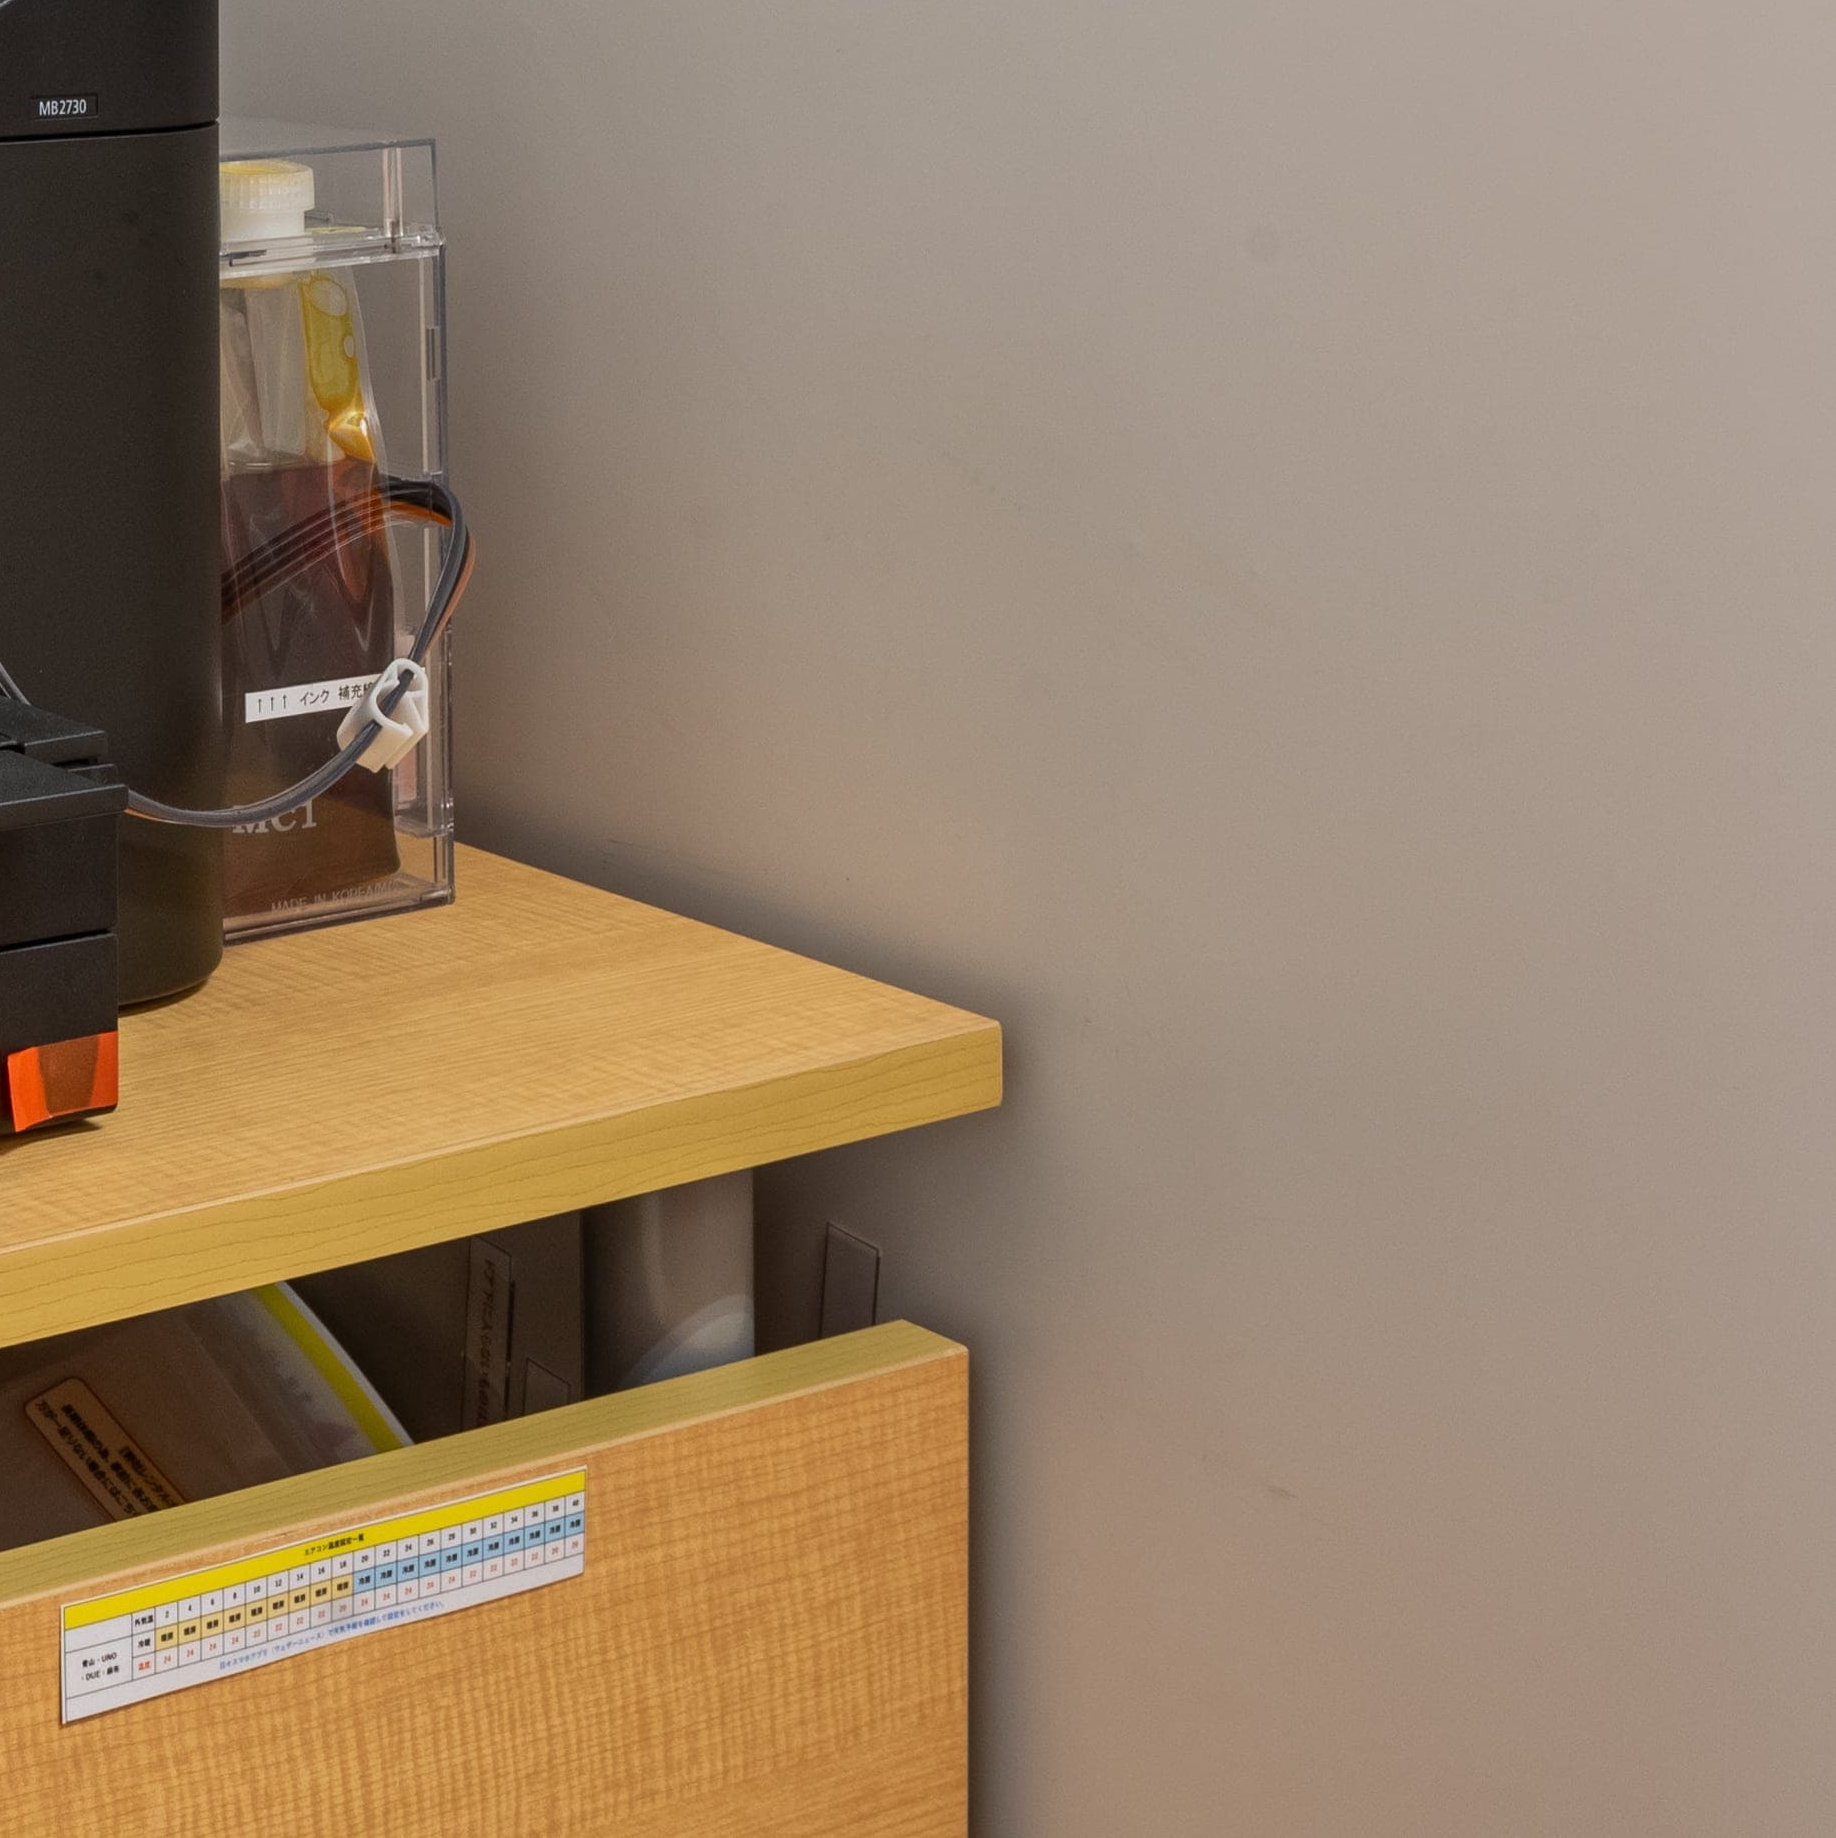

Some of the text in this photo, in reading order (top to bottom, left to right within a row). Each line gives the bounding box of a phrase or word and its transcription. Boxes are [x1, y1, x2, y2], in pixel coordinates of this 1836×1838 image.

[39, 98, 87, 116] MB2730
[299, 690, 330, 706] インク
